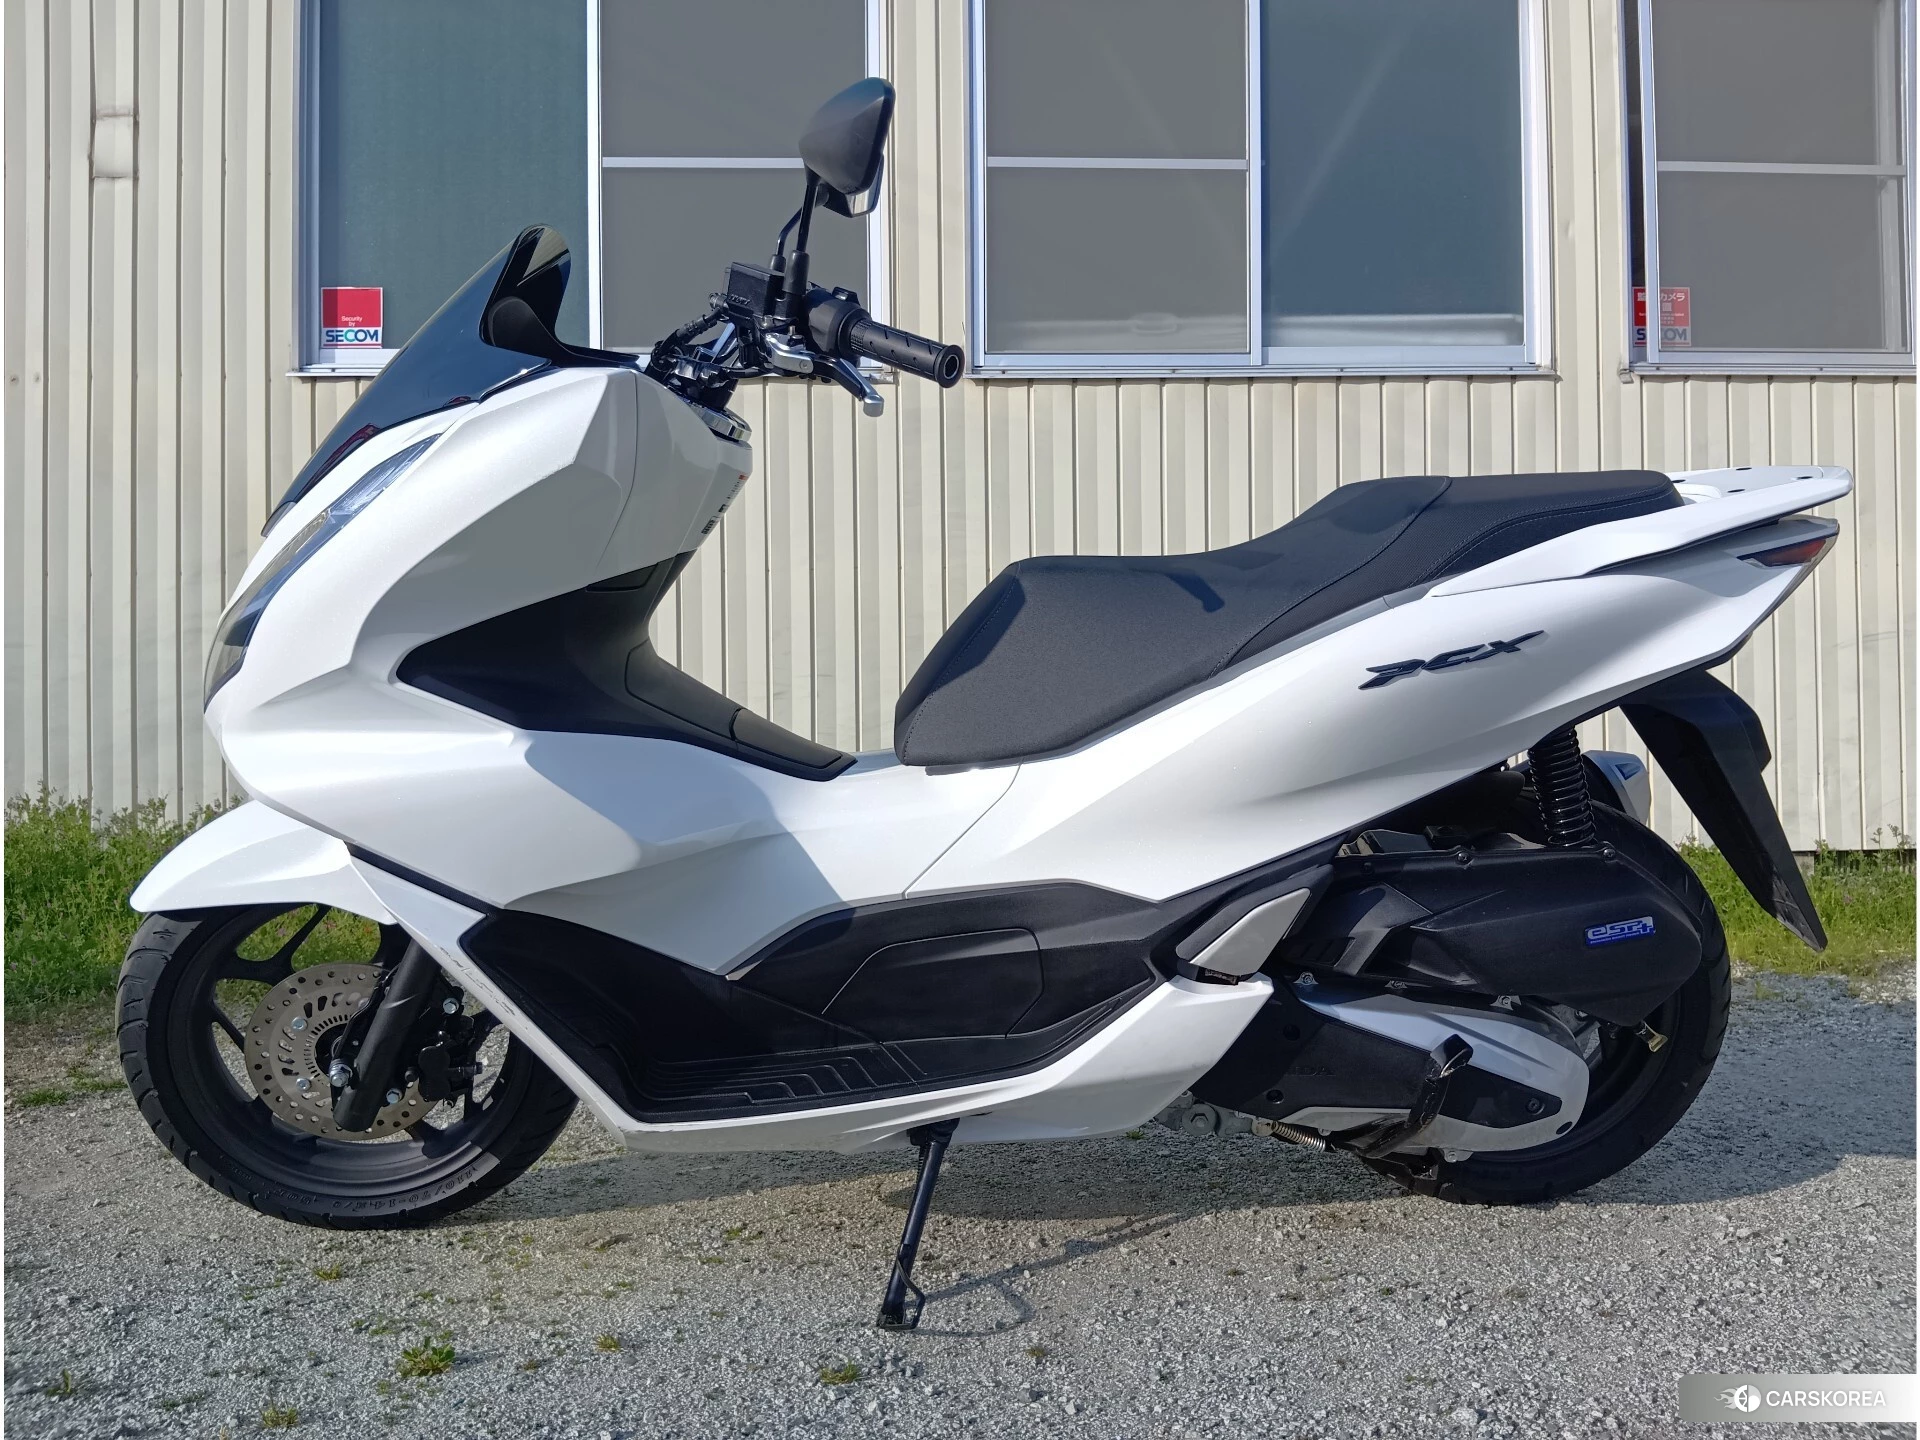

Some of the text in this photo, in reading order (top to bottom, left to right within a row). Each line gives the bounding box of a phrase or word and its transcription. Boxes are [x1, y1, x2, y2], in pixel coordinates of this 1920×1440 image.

[325, 329, 379, 342] SECOM
[1636, 328, 1687, 341] SOM
[1358, 630, 1545, 690] PCX
